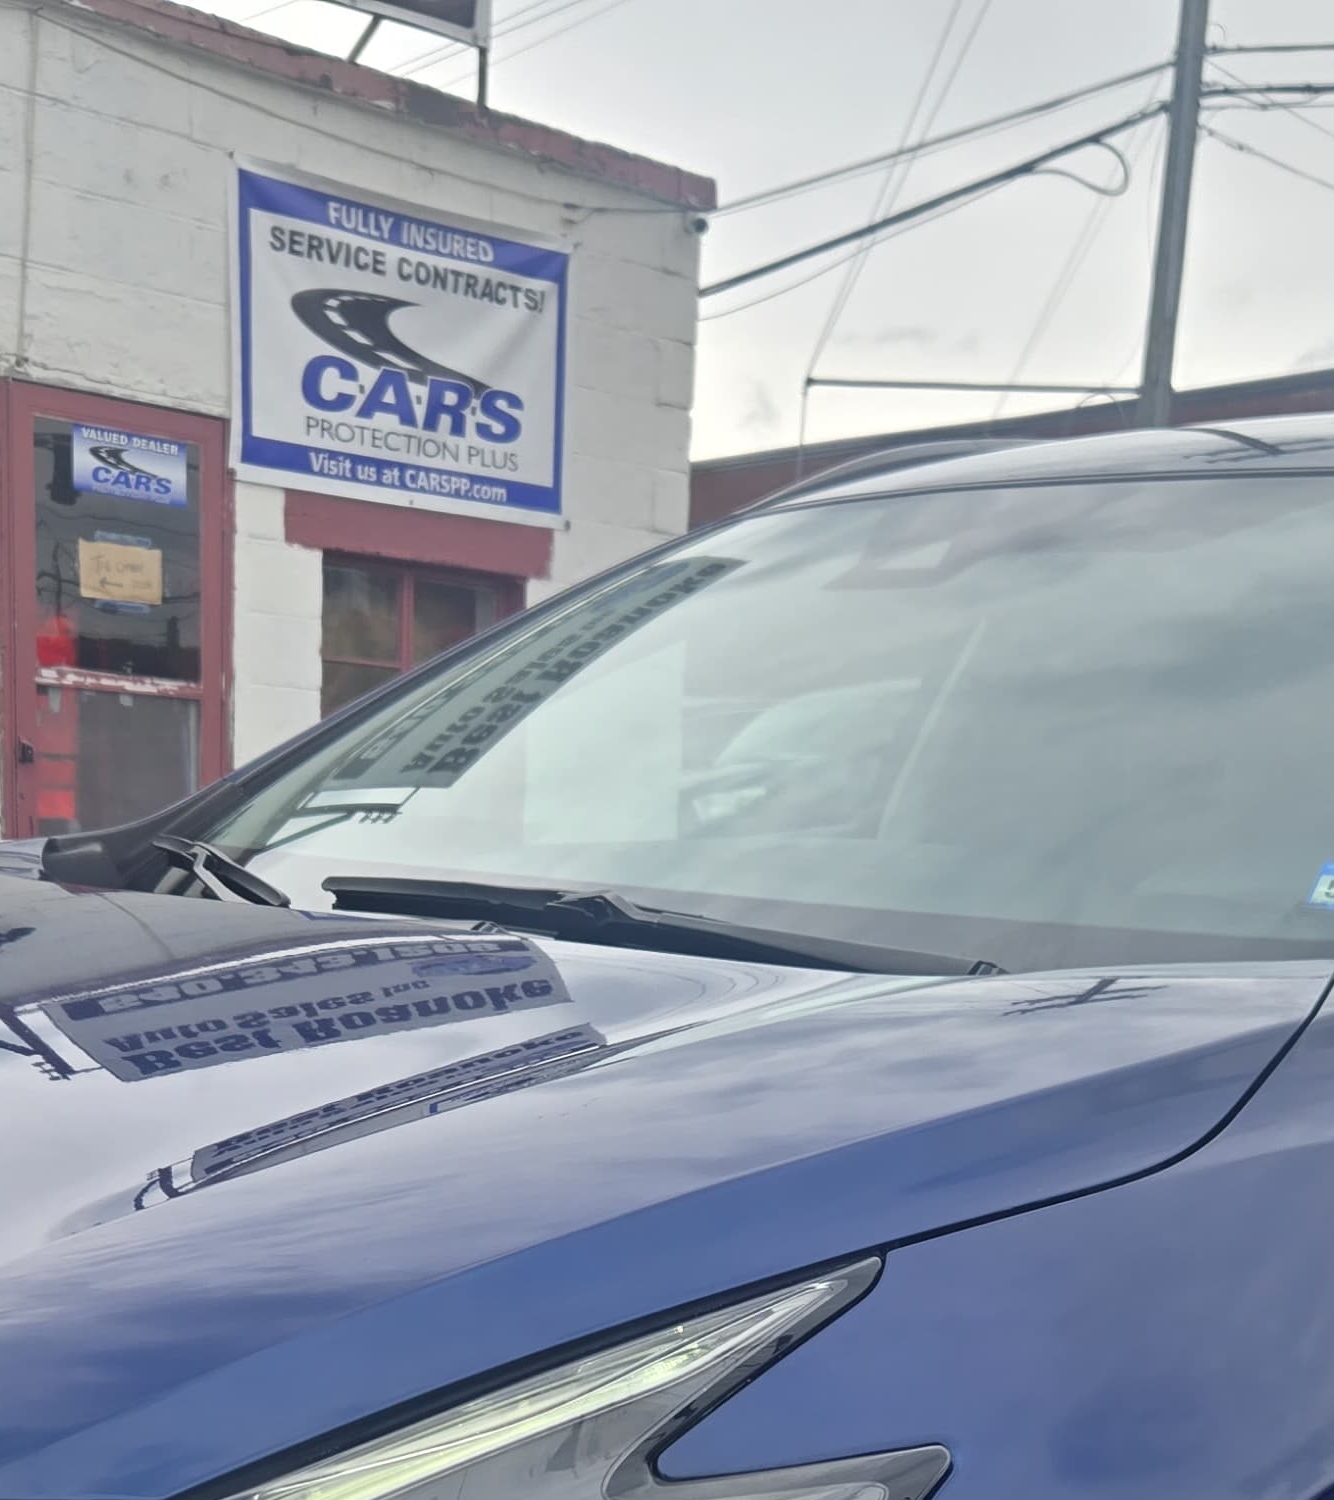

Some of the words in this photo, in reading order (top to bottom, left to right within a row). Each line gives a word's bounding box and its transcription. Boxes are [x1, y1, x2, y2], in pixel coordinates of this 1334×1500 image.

[328, 201, 394, 240] FULLY
[401, 221, 494, 263] INSURED
[269, 225, 386, 277] SERVICE
[397, 257, 546, 313] CONTRACTS!
[81, 427, 128, 445] VALUED
[132, 437, 179, 456] DEALER
[306, 415, 460, 463] PROTECTION
[468, 445, 519, 472] PLUS
[309, 451, 351, 477] Visit
[357, 464, 376, 481] us
[382, 465, 400, 487] at
[405, 469, 508, 503] CARSPP.com
